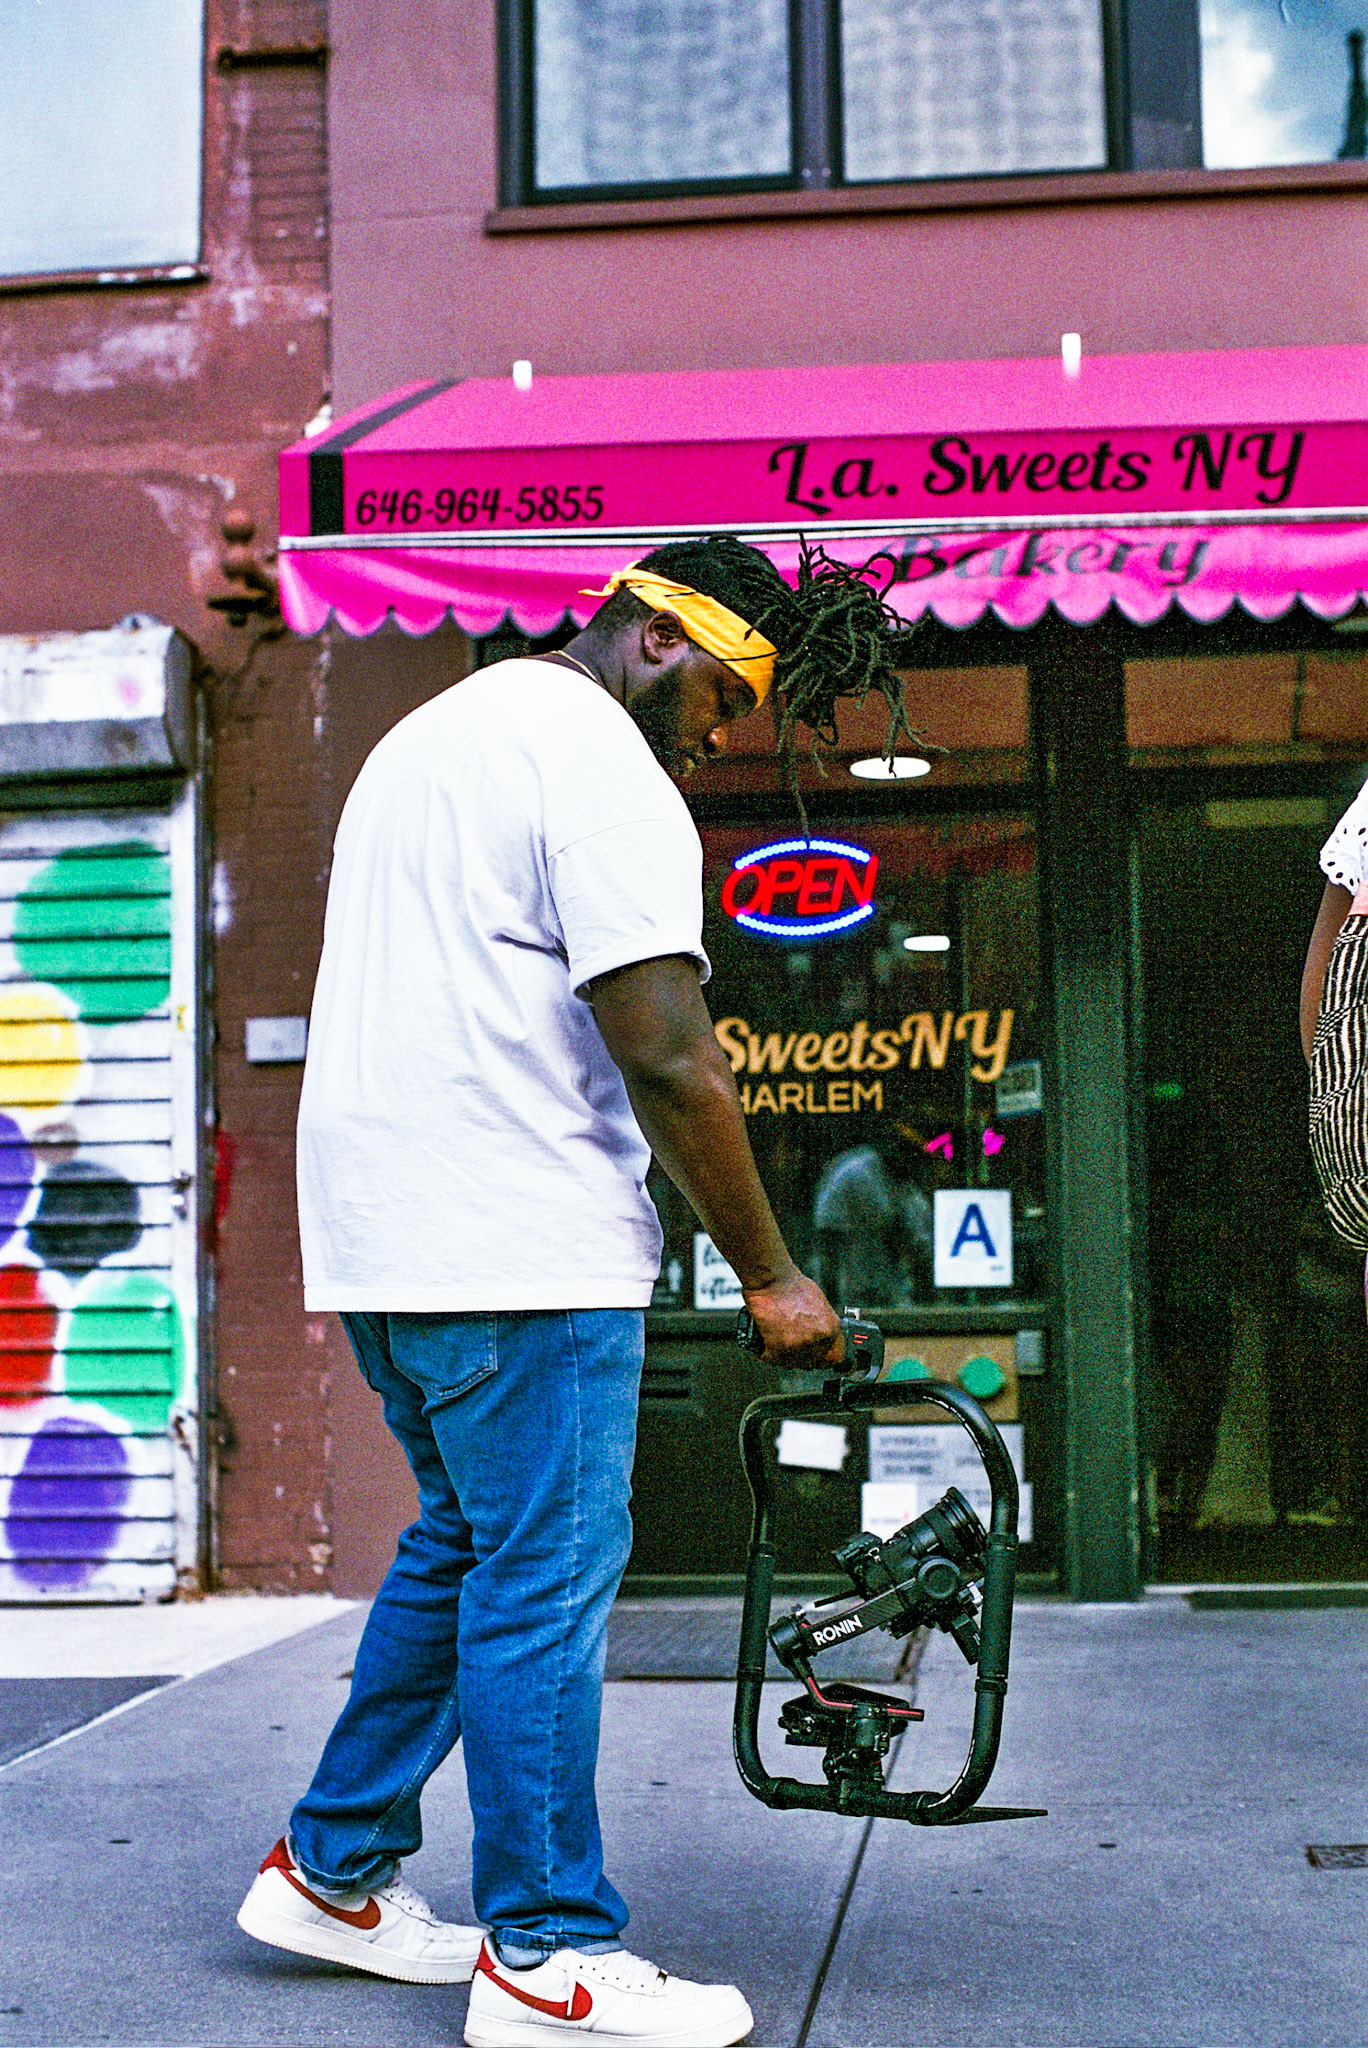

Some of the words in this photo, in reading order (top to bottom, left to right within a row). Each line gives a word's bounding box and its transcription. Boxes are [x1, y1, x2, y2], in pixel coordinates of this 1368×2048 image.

[923, 435, 1152, 495] Sweets
[1173, 432, 1304, 504] NY
[356, 485, 604, 525] 646-964-5855
[883, 532, 1210, 587] Bakery
[721, 855, 879, 917] OPEN
[950, 1203, 997, 1258] A
[812, 1614, 863, 1646] RONIN
